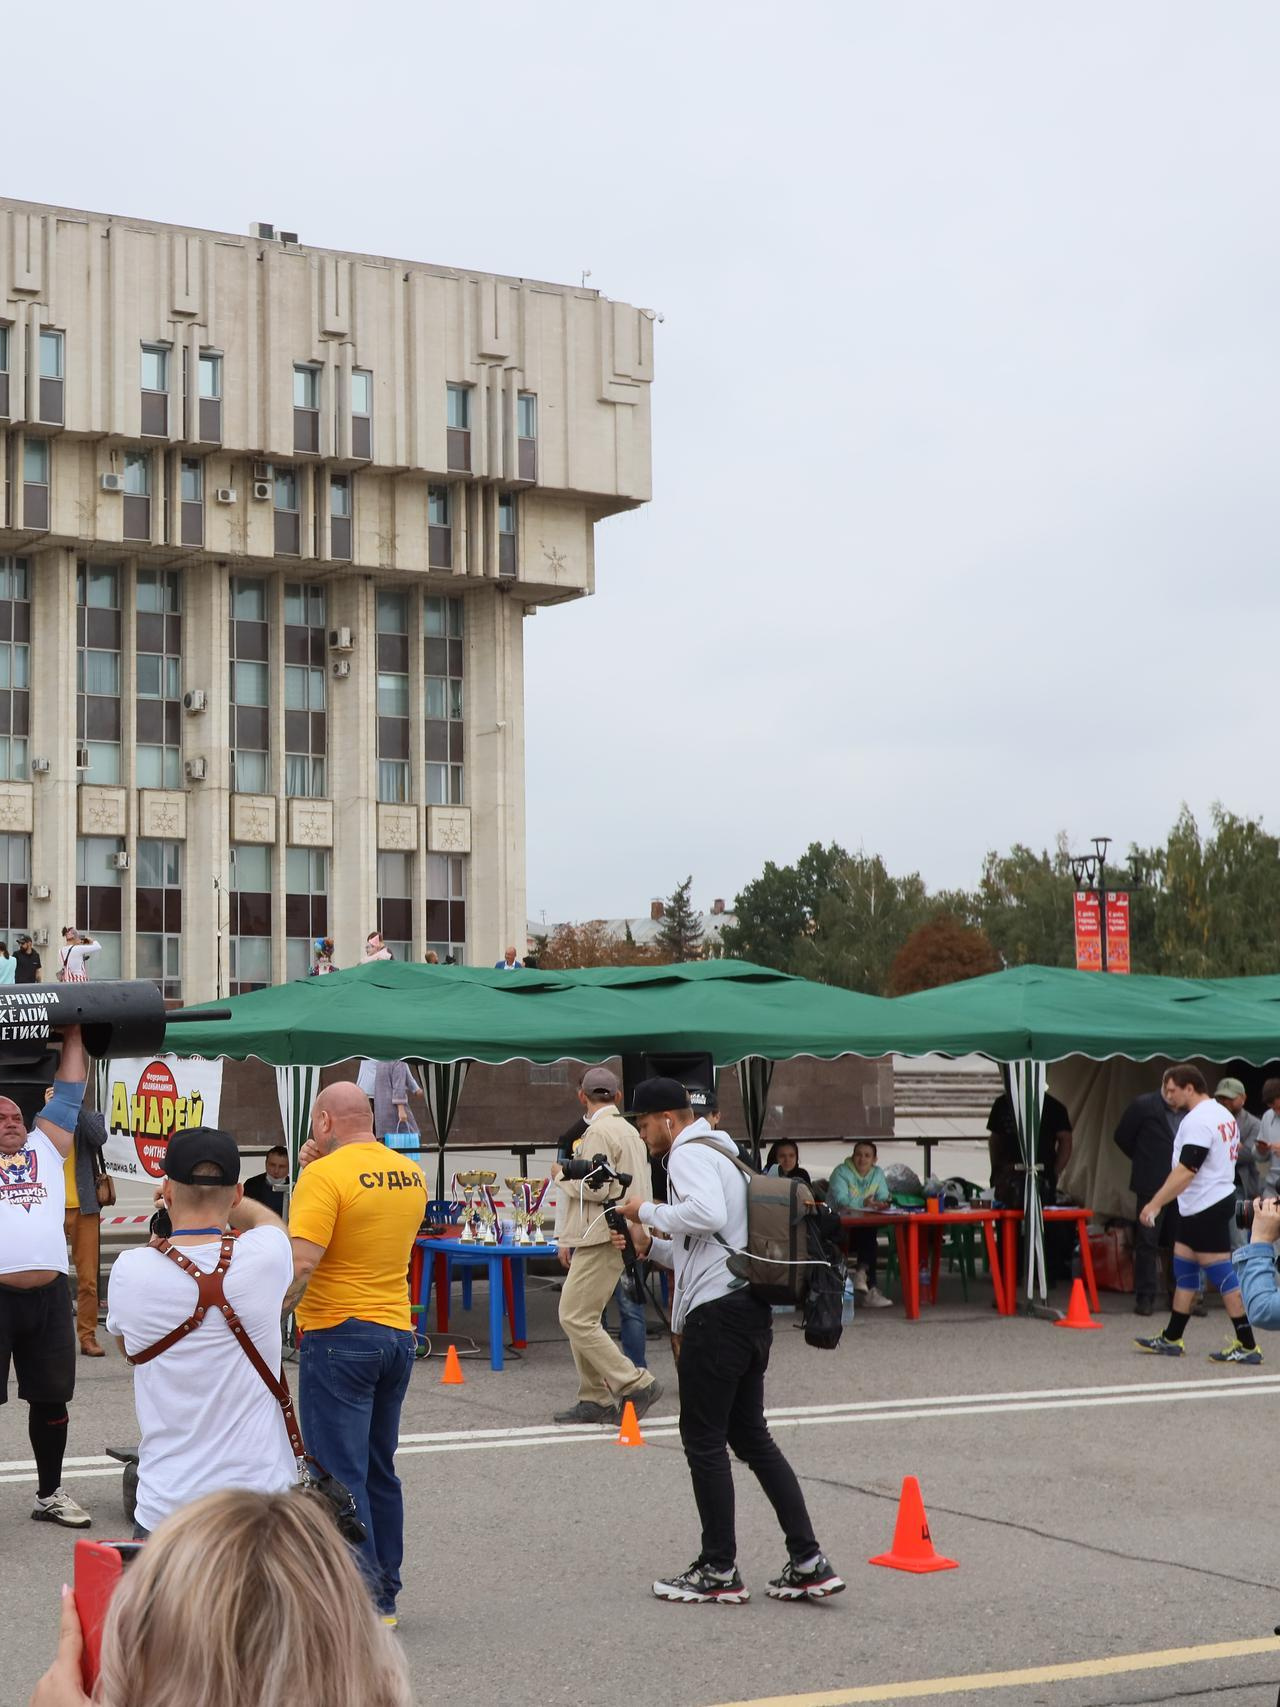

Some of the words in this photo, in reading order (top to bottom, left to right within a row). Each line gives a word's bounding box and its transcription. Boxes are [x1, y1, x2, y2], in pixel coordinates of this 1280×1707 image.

[143, 1144, 168, 1160] ФИТНЕ
[128, 1162, 137, 1175] 94
[359, 1170, 422, 1191] СУДЬЯ
